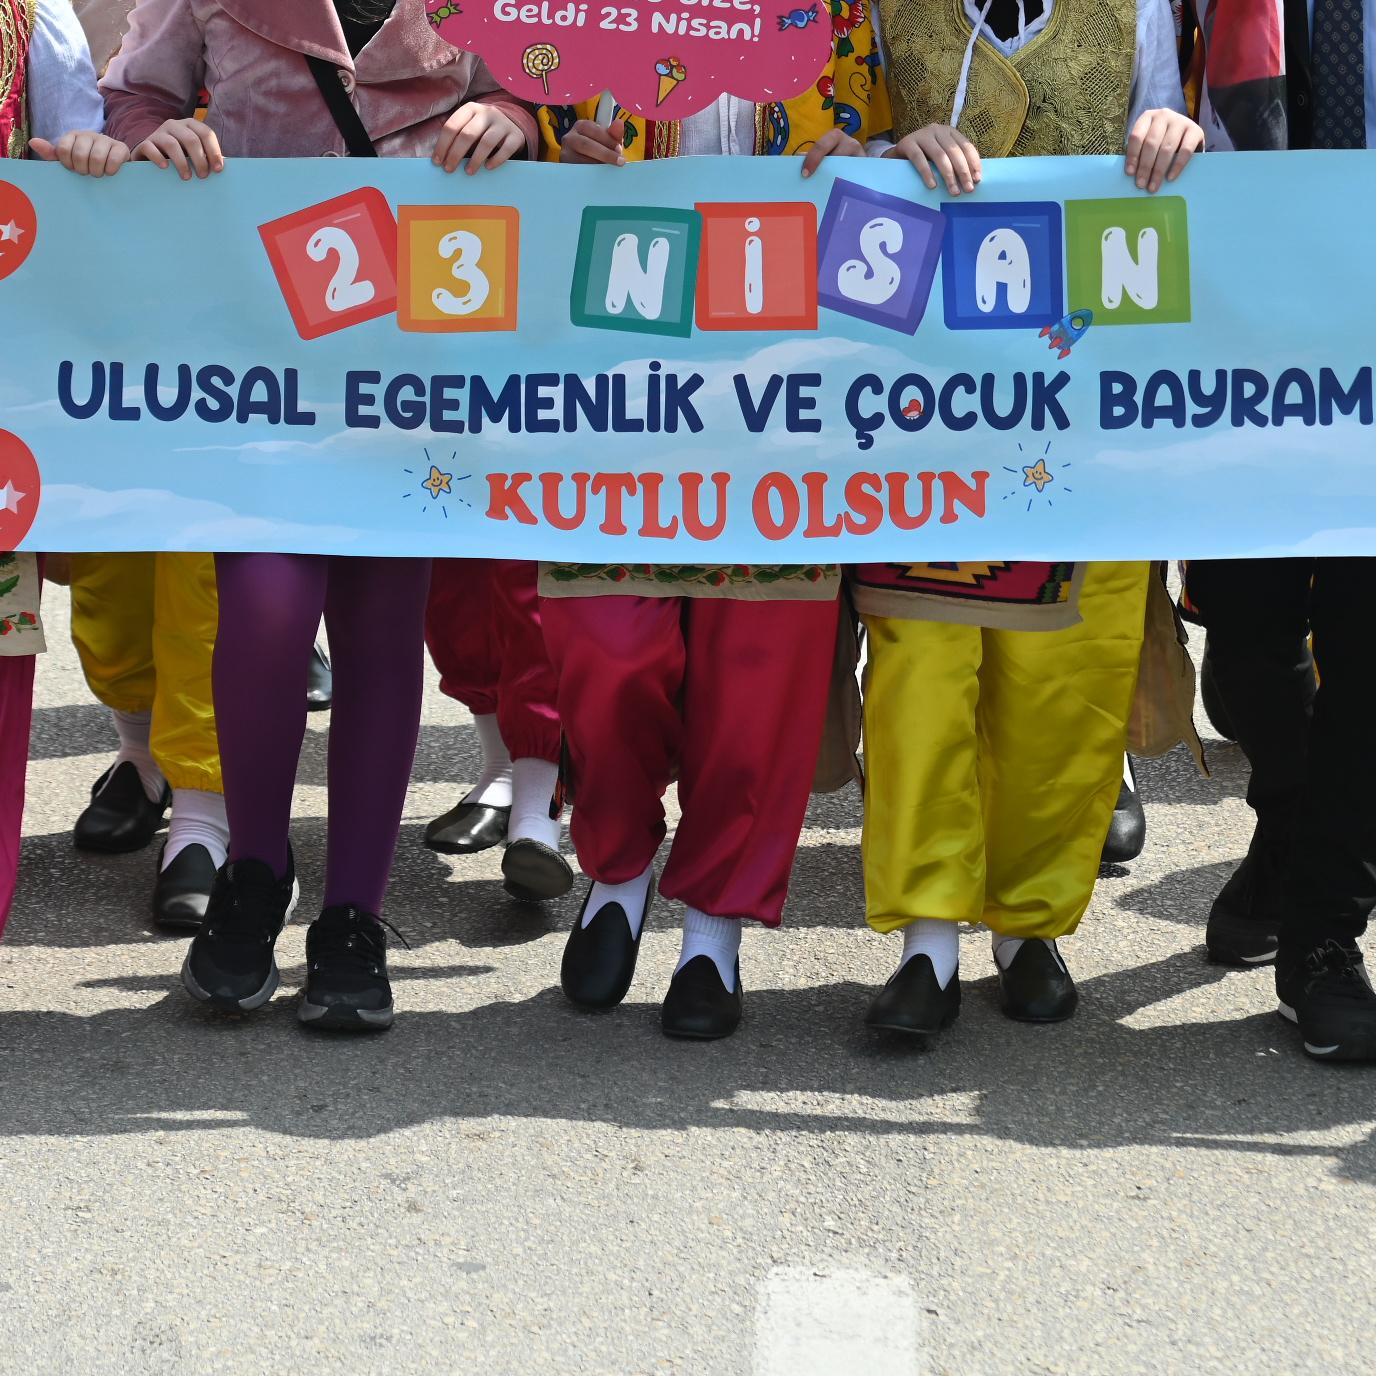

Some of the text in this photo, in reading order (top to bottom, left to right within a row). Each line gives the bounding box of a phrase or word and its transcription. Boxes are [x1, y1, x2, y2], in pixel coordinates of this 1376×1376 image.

[599, 6, 639, 32] 23
[651, 11, 762, 42] Nisan!
[305, 216, 1159, 320] 23 NİSAN
[57, 360, 316, 426] ULUSAL
[344, 361, 705, 434] EGEMENLİK
[733, 373, 822, 433] VE
[844, 370, 1072, 451] ÇOCUK
[484, 470, 991, 541] KUTLU OLSUN
